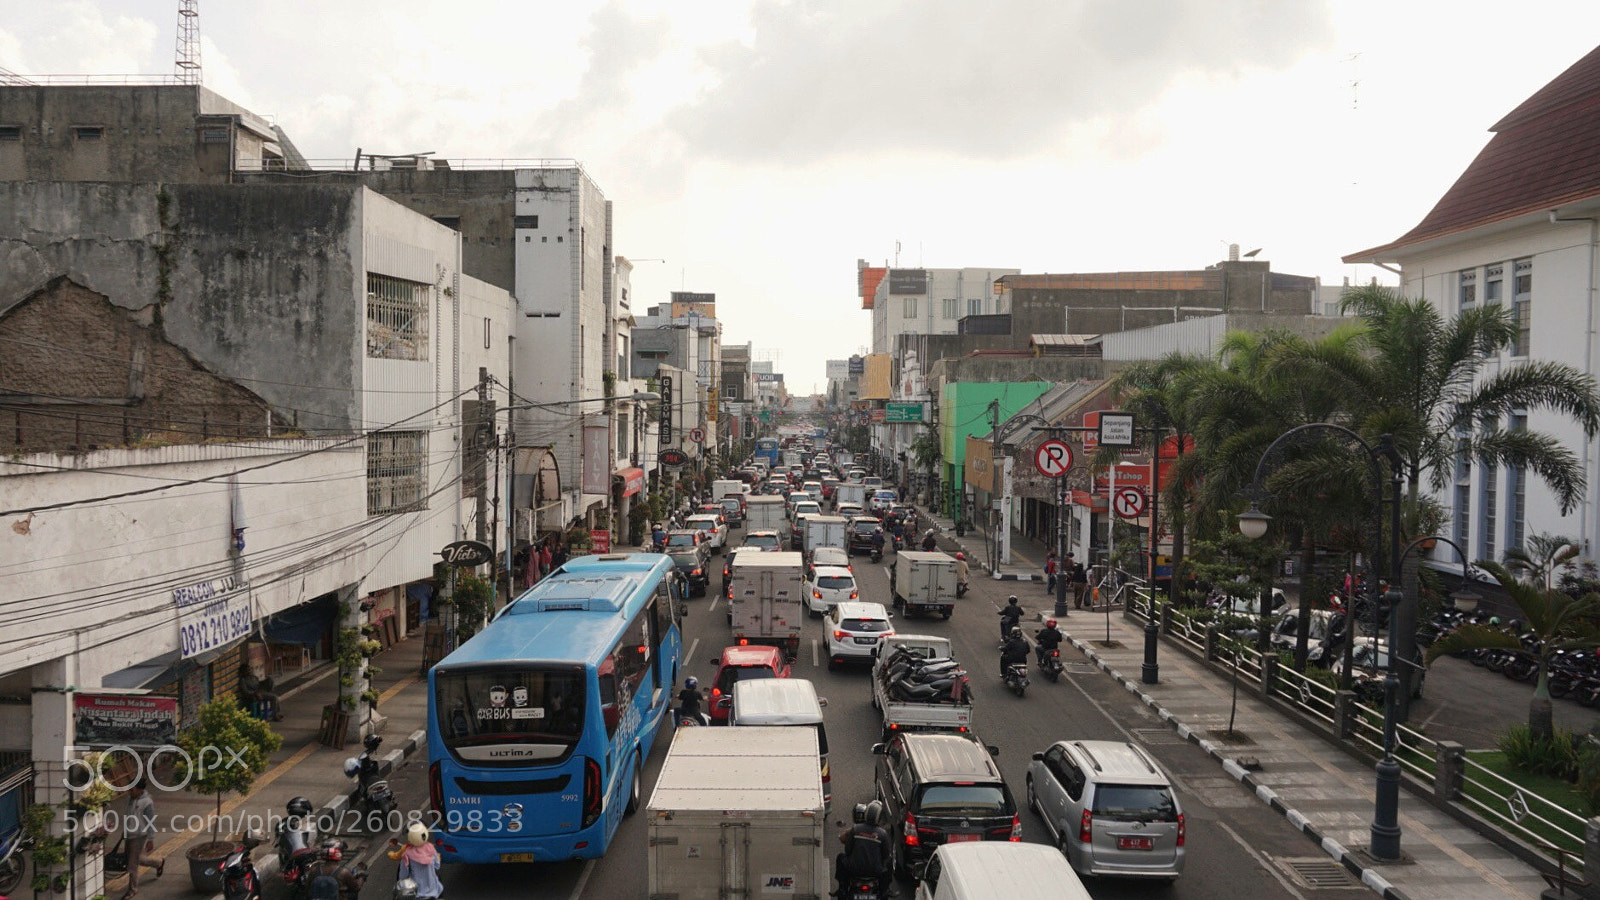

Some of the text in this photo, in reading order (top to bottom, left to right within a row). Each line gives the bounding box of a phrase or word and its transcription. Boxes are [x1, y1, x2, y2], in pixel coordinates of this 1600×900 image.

[662, 378, 670, 435] GALOMAS
[1103, 420, 1131, 428] Sepanjang
[181, 621, 210, 656] 0812
[210, 615, 229, 646] 210
[94, 698, 156, 708] Rumah Makan
[79, 706, 172, 719] Nusantara Indah
[494, 707, 511, 720] BUS
[450, 797, 481, 805] DAMRI
[561, 794, 579, 802] 5992
[765, 876, 794, 888] JNE
